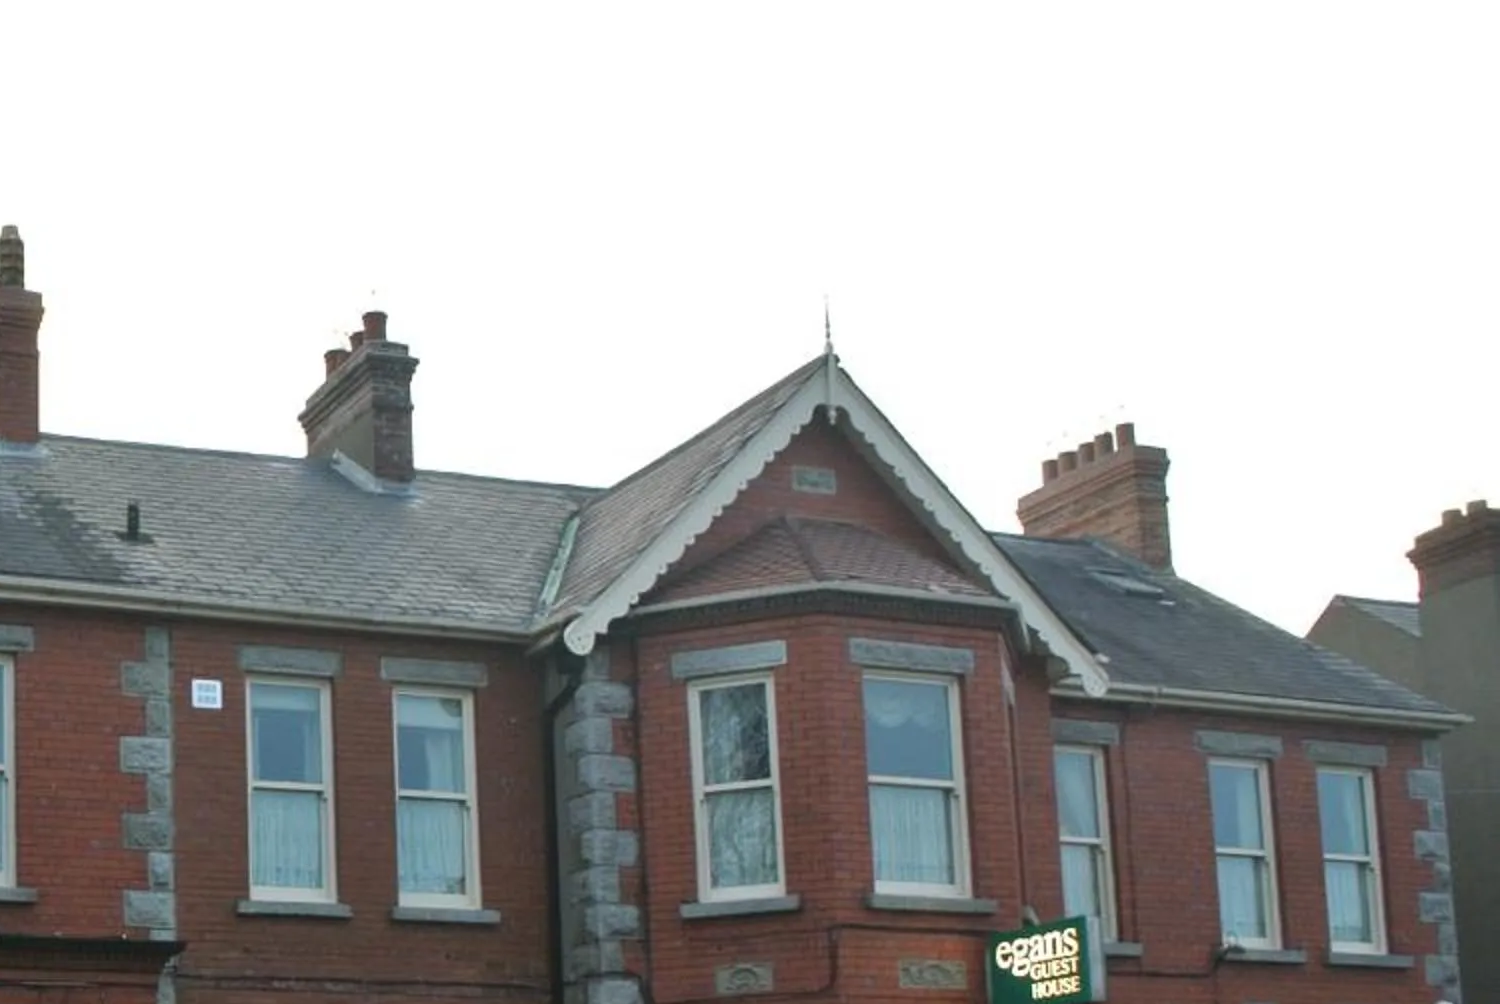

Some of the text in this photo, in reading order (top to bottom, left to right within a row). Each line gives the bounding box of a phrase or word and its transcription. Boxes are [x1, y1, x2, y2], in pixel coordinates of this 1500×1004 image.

[995, 928, 1080, 977] egans
[1030, 957, 1080, 981] GUEST
[1031, 976, 1081, 1000] HOUSE
